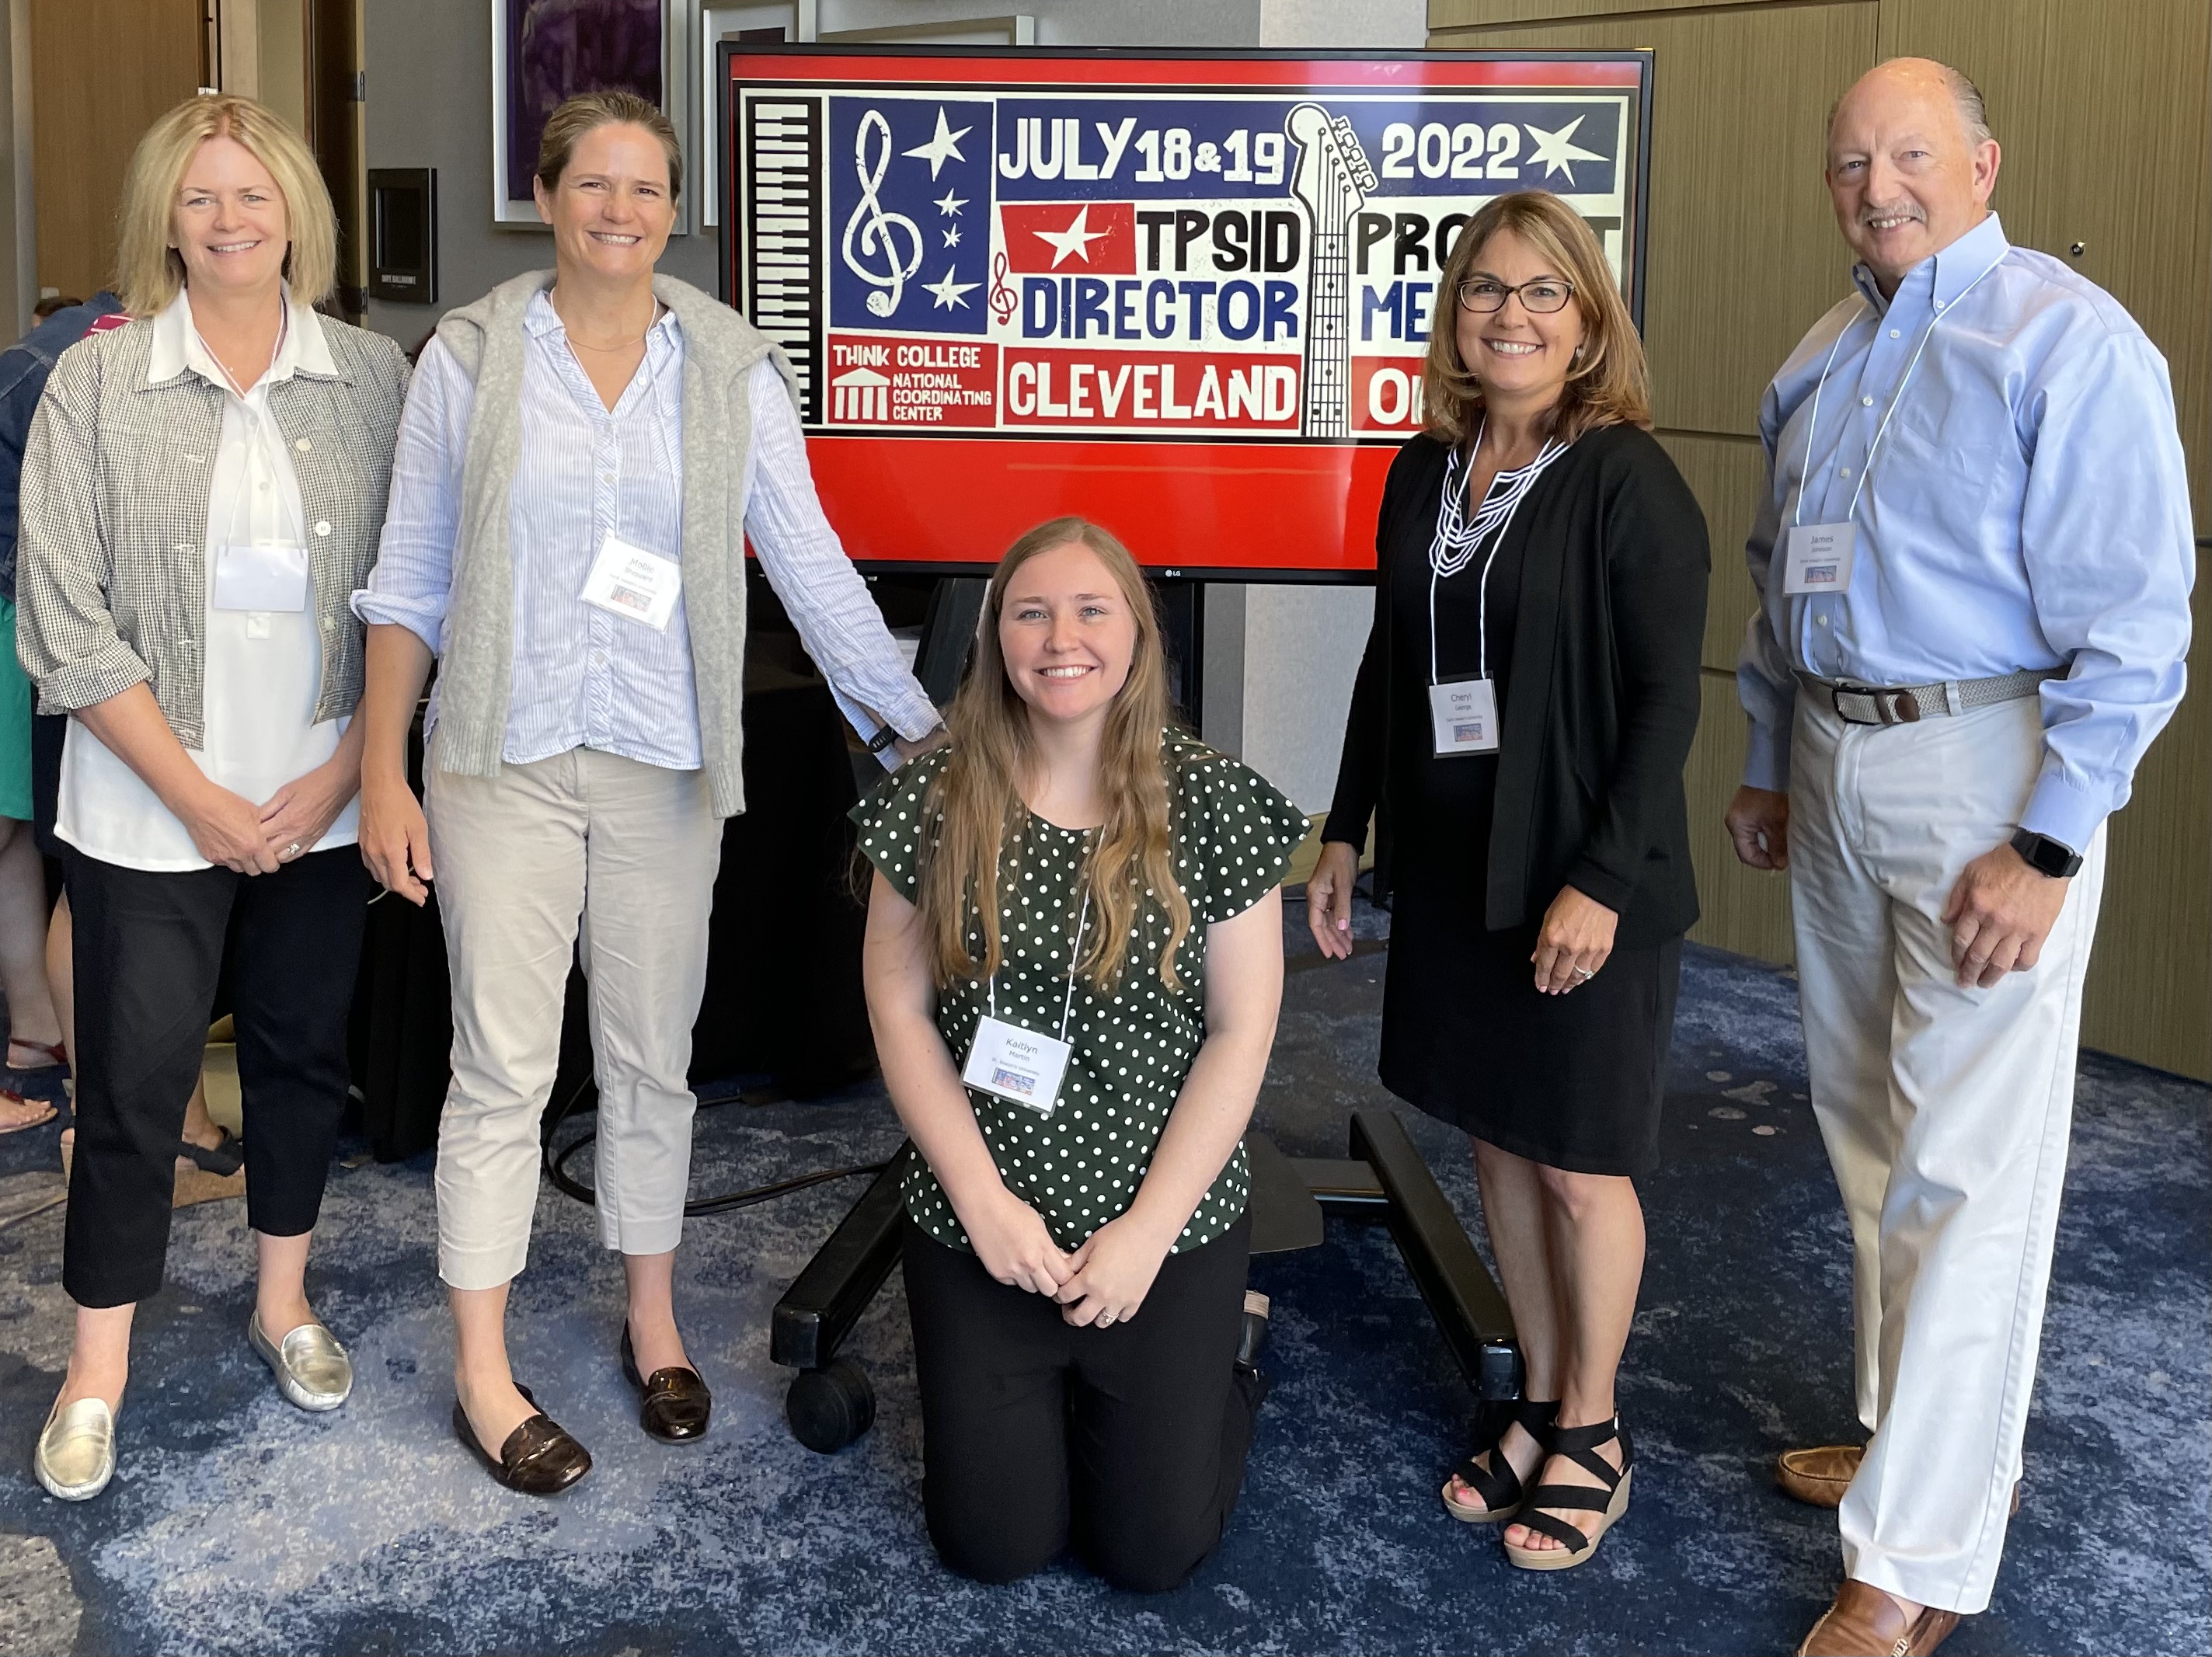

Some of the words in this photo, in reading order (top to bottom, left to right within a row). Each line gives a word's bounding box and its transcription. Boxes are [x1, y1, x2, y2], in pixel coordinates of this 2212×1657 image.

[999, 117, 1137, 181] JULY
[1381, 122, 1520, 179] 2022
[1136, 210, 1301, 273] TPSID
[1022, 277, 1298, 343] DIRECTOR
[833, 345, 890, 367] THINK
[897, 346, 981, 368] COLLEGE
[893, 373, 963, 389] NATIONAL
[893, 390, 992, 406] COORDINATING
[1008, 361, 1298, 422] CLEVELAND
[893, 406, 943, 421] CENTER
[1810, 535, 1834, 545] James
[1451, 692, 1472, 702] Cheryl
[1005, 1038, 1039, 1054] Kaitlyn
[1008, 1050, 1030, 1062] Martin
